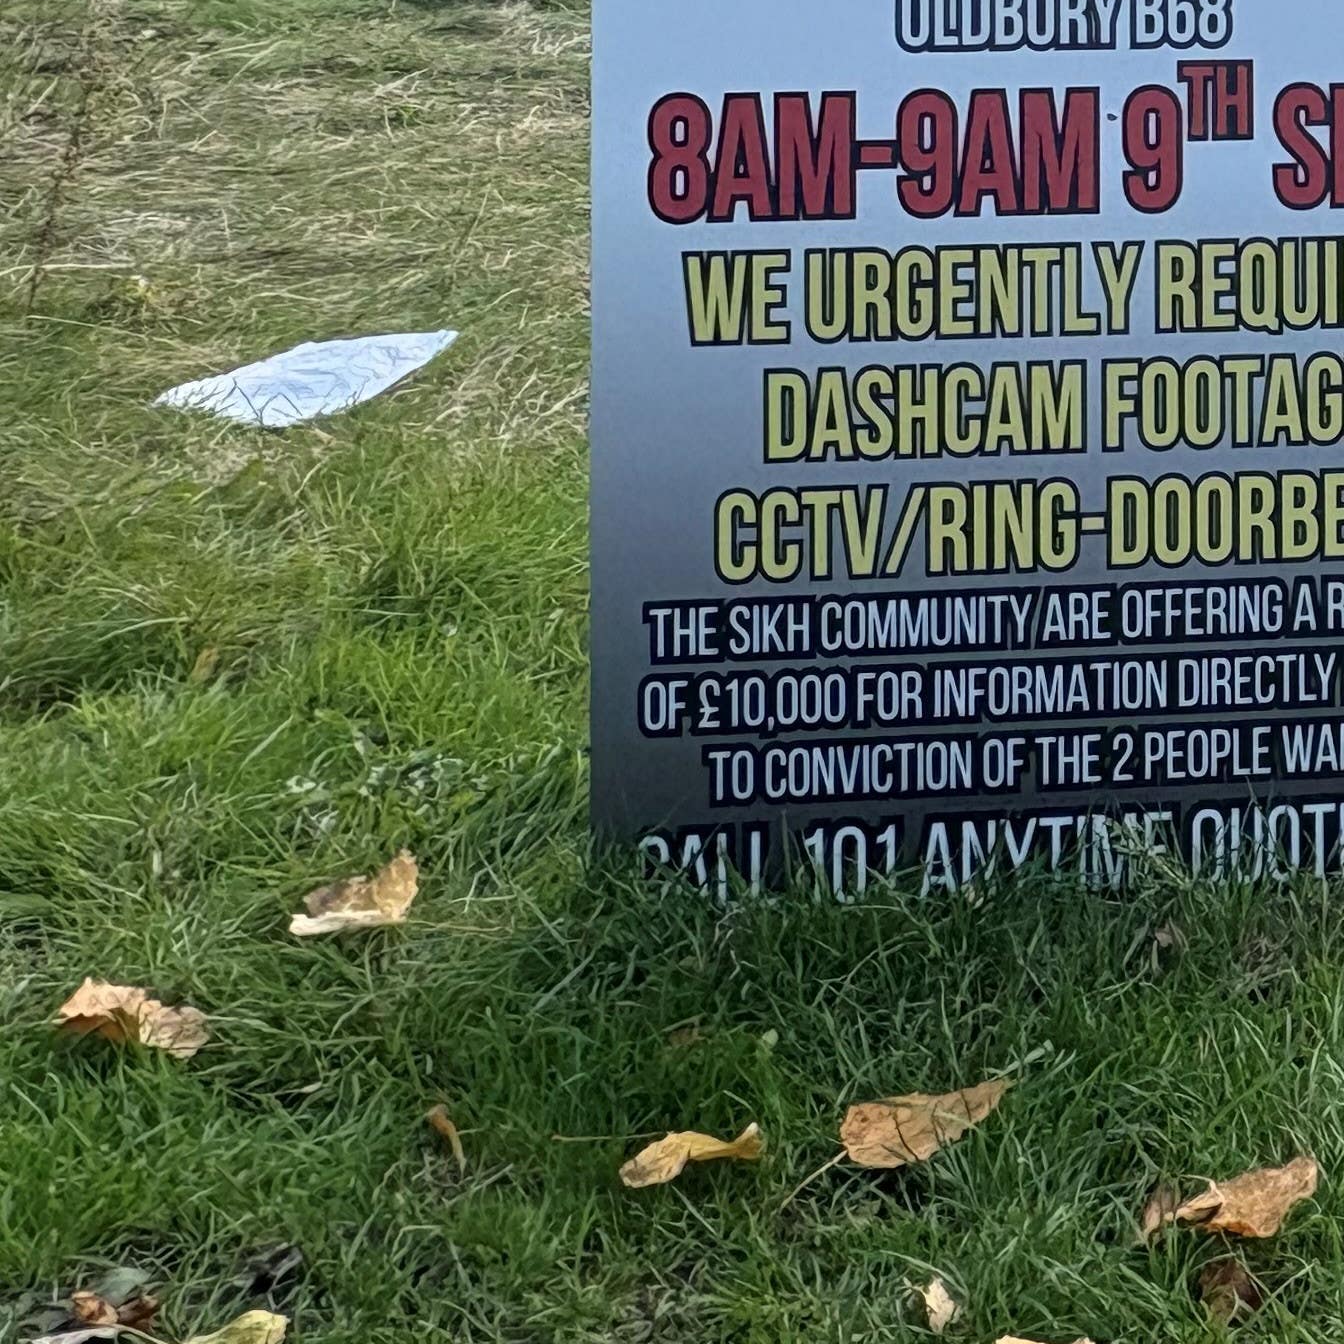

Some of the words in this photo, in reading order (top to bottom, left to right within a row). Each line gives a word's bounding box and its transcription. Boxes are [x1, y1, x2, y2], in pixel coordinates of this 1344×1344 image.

[647, 87, 1100, 223] 8AM-9AM
[682, 249, 791, 346] WE
[805, 240, 1145, 344] URGENTLY
[764, 359, 1087, 463] DASHCAM
[649, 606, 719, 657] THE
[728, 603, 810, 655] SIKH
[820, 593, 1033, 651] COMMUNITY
[1043, 591, 1111, 641] ARE
[1121, 584, 1284, 638] OFFERING
[1293, 583, 1317, 631] A
[644, 680, 688, 730] OF
[699, 674, 846, 731] £10,000
[857, 671, 922, 721] FOR
[933, 660, 1167, 717] INFORMATION
[1179, 652, 1336, 707] DIRECTLY
[709, 750, 754, 800] TO
[765, 741, 971, 797] CONVICTION
[983, 738, 1024, 787] OF
[1036, 734, 1102, 785] THE
[1113, 733, 1134, 782] 2
[1145, 726, 1271, 781] PEOPLE
[804, 824, 898, 904] 101
